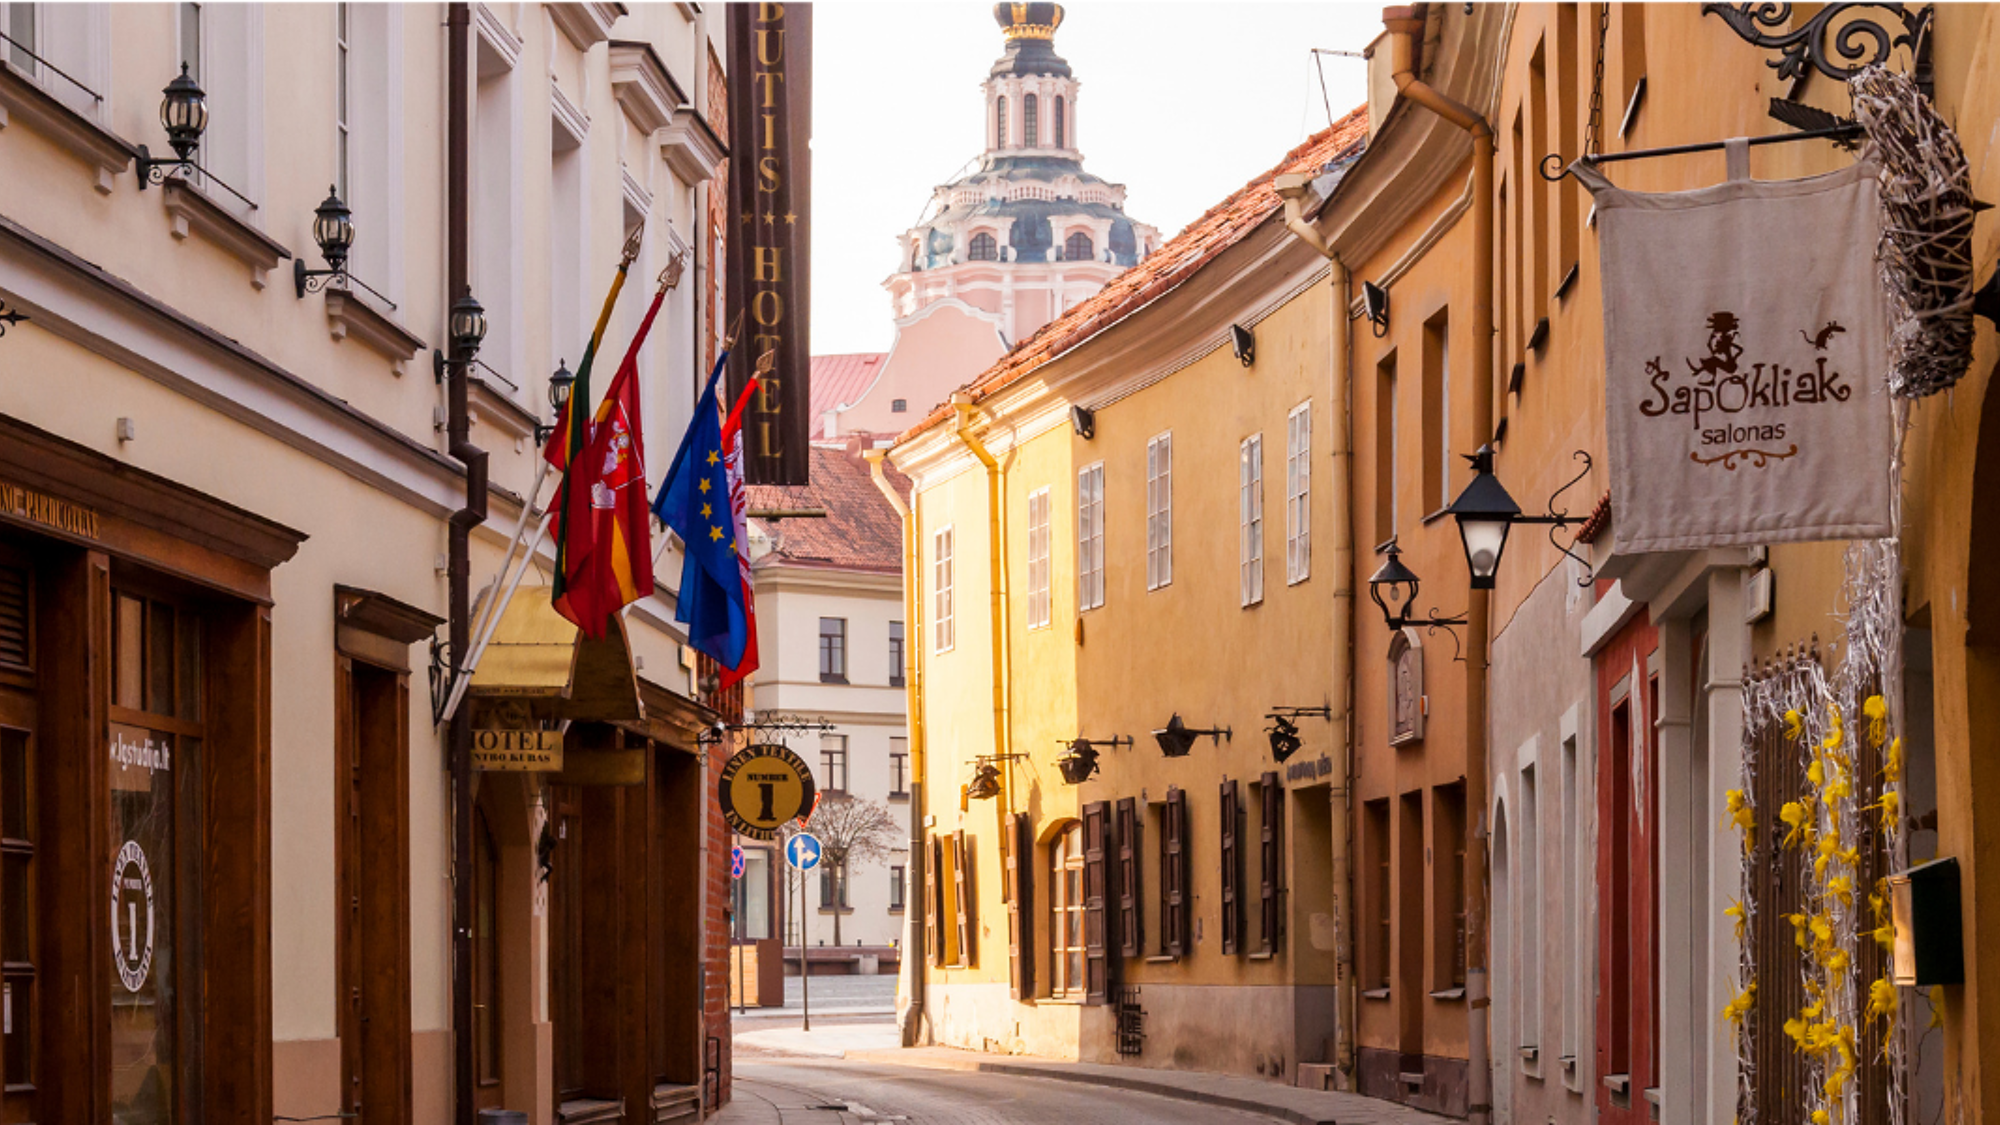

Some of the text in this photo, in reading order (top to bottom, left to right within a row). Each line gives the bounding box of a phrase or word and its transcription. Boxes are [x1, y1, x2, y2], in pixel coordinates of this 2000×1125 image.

[752, 246, 784, 459] HOTEL
[1701, 423, 1786, 445] salonas
[474, 753, 507, 762] NTRO
[721, 744, 813, 783] LINEN TEXTILE
[746, 773, 789, 782] NUMBER
[756, 783, 777, 821] 1
[128, 902, 139, 961] 1
